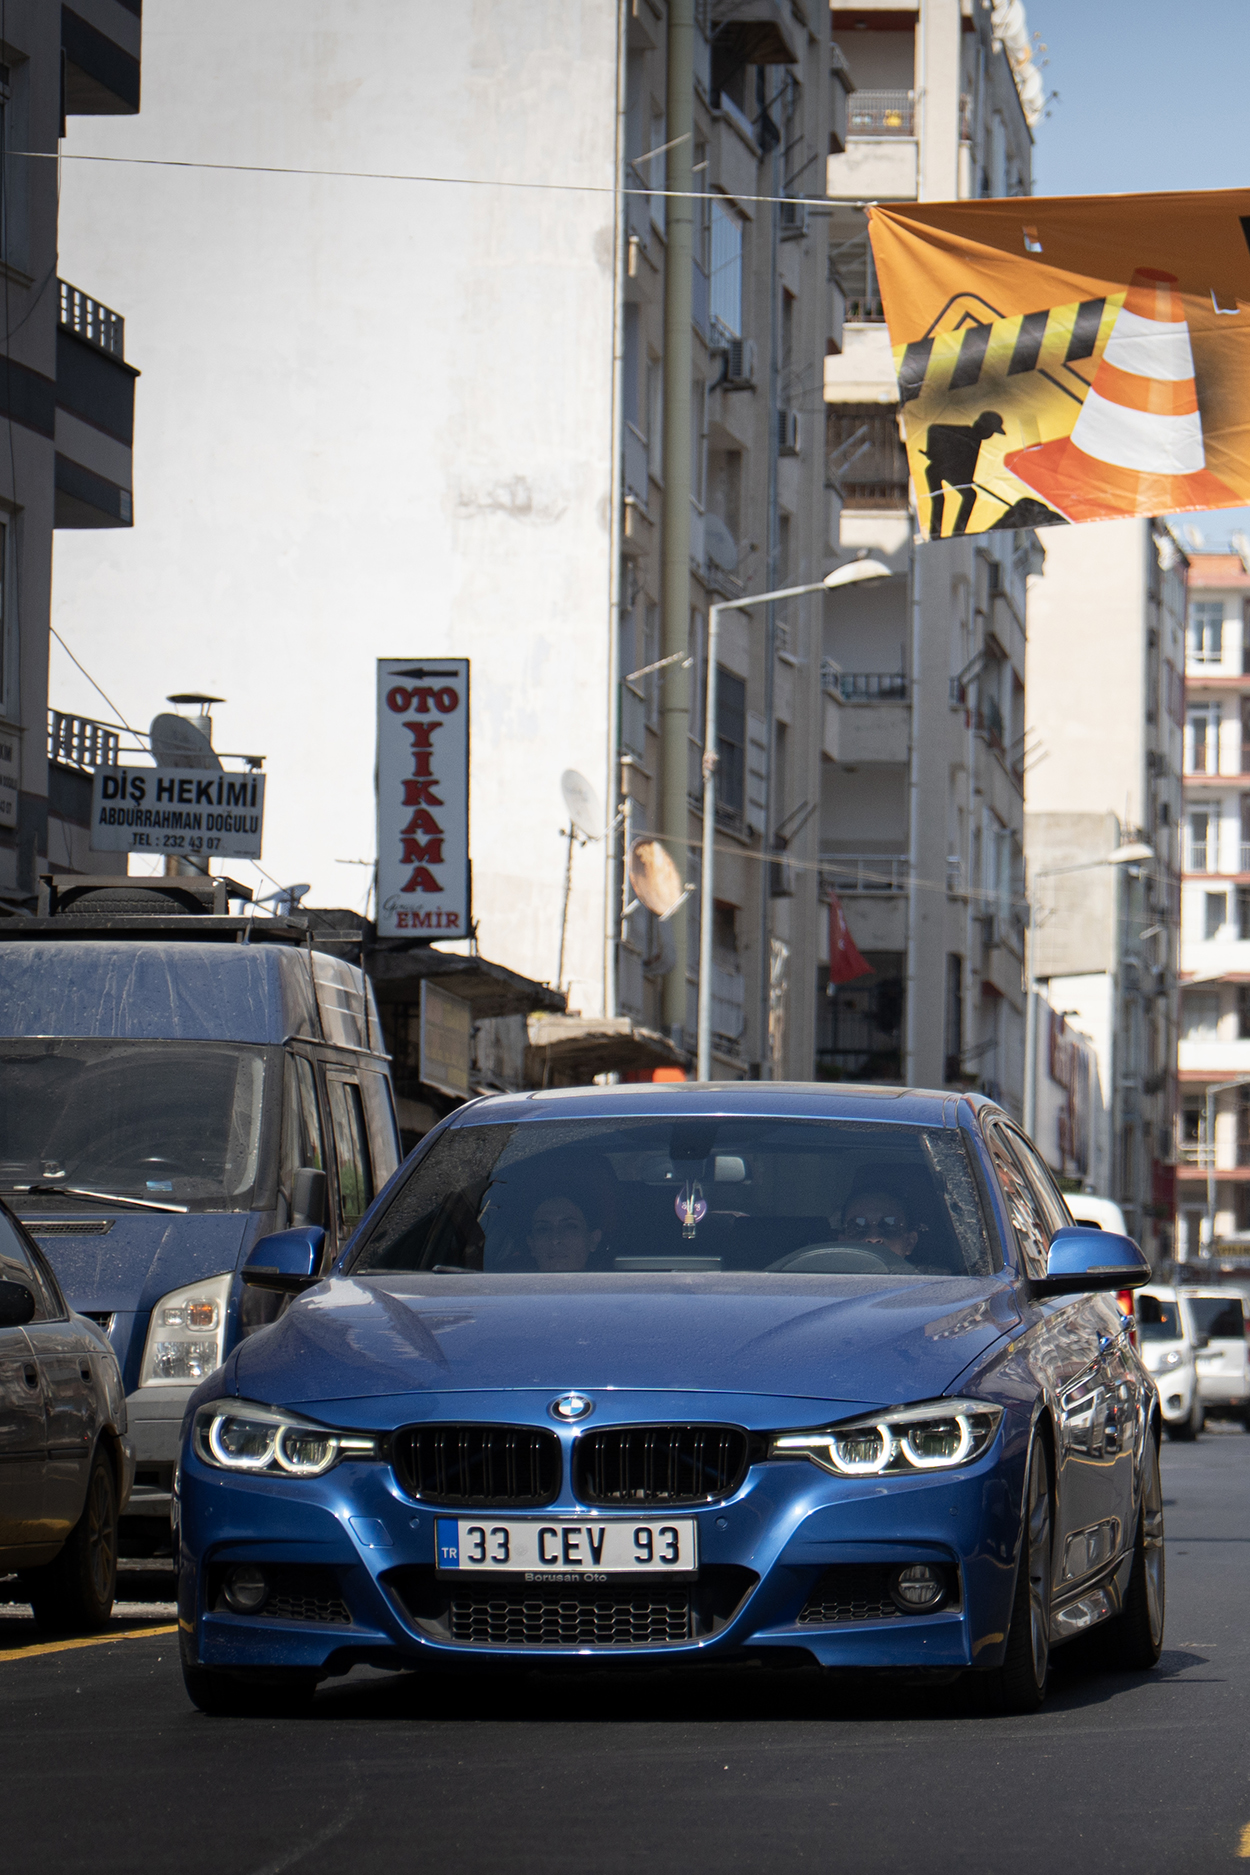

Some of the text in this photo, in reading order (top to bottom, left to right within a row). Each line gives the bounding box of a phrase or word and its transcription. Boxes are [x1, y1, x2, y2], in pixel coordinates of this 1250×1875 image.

[386, 685, 459, 714] OTO
[101, 770, 258, 808] DİŞ HEKİMİ
[99, 806, 259, 834] ABDURRAHMAN DOĞULU
[399, 720, 446, 893] YIKAMA
[132, 832, 151, 846] TEL
[163, 834, 185, 848] 232
[188, 836, 204, 850] 43
[206, 837, 222, 850] 07
[395, 906, 461, 930] EMİR
[441, 1547, 458, 1559] TR
[466, 1526, 680, 1566] 33 CEV 93
[525, 1573, 608, 1582] Borusan Oto
